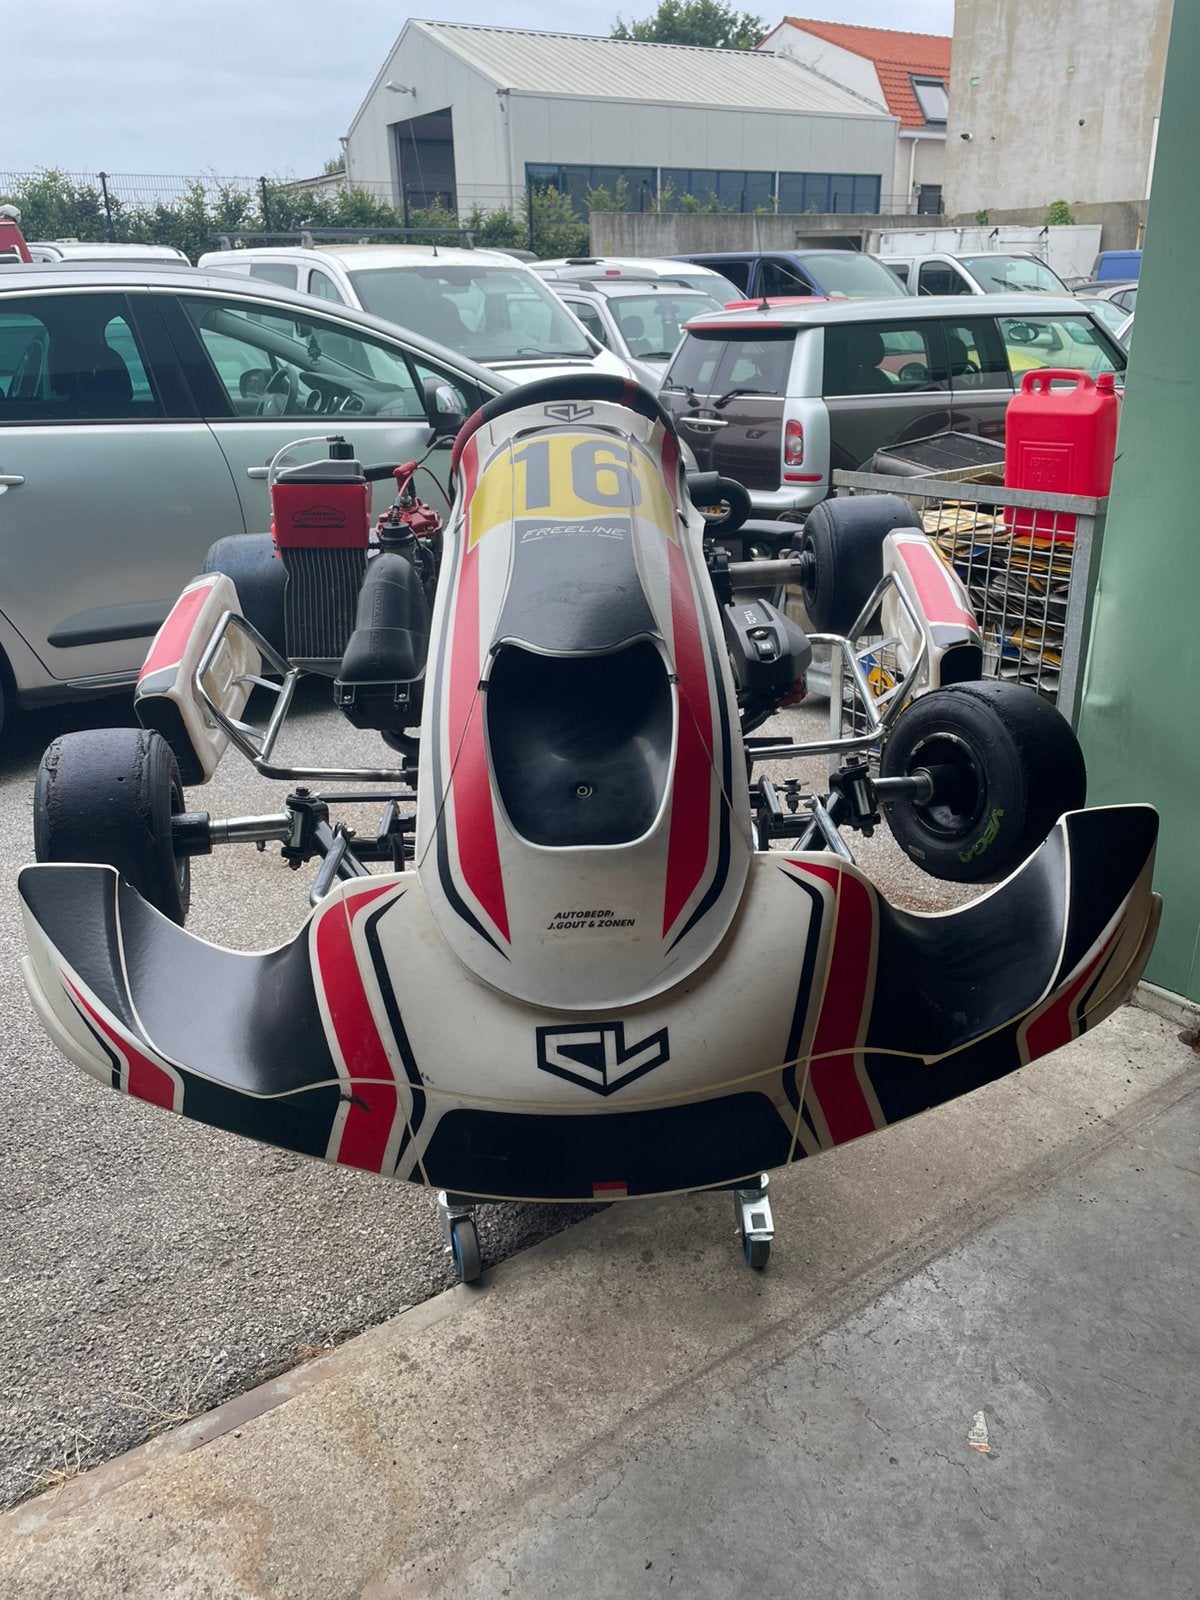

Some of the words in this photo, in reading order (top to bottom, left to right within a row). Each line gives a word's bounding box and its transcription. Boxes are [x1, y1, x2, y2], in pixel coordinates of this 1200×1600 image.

[510, 440, 642, 510] 16
[522, 525, 627, 540] FREELINE
[958, 808, 1004, 864] VEGA
[547, 921, 586, 930] J.GOUT
[588, 920, 595, 928] &
[597, 919, 635, 928] ZONEN
